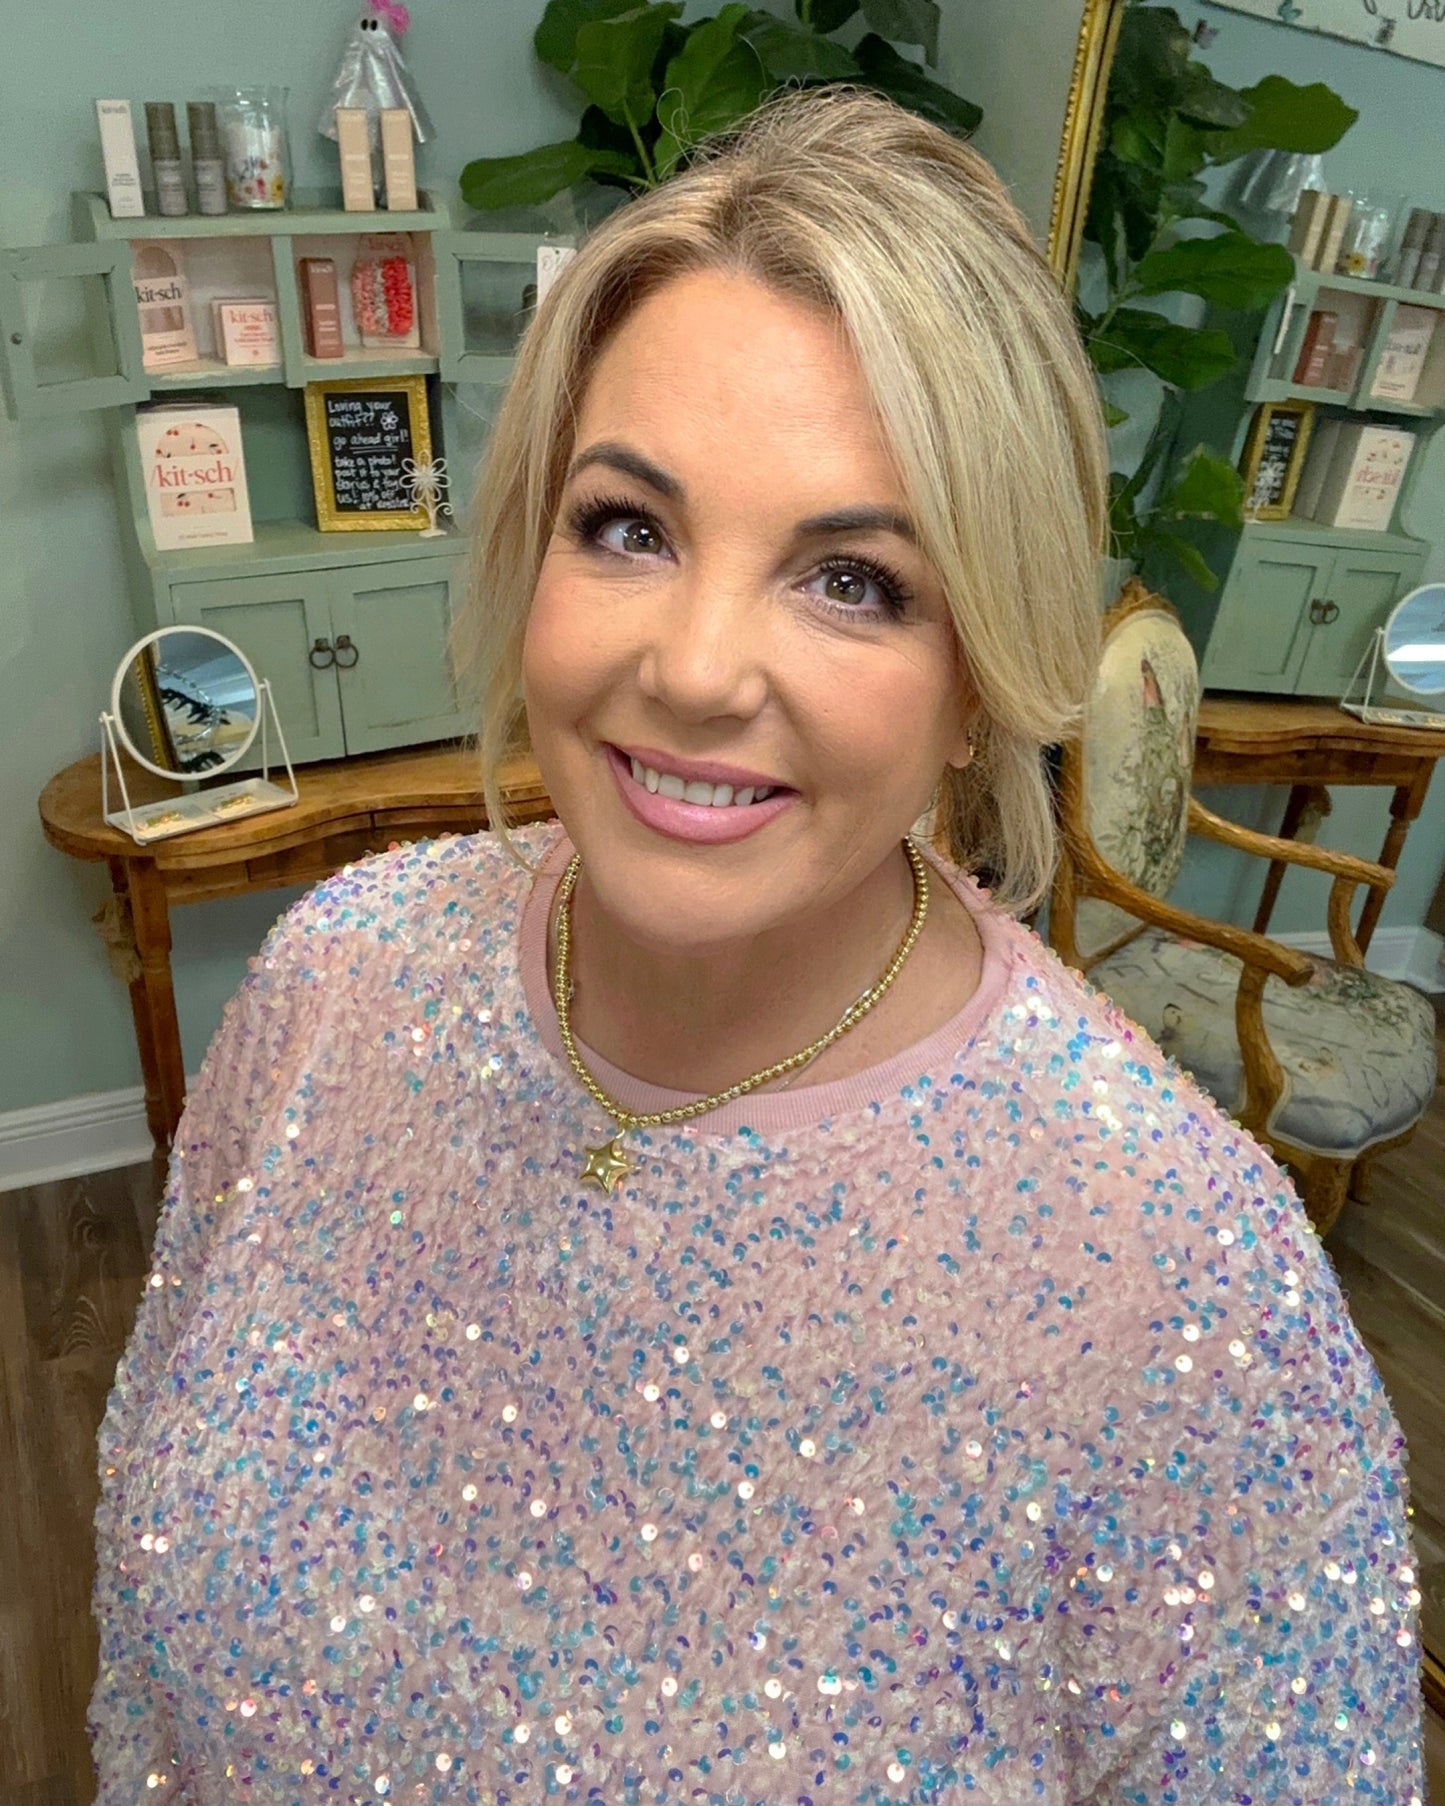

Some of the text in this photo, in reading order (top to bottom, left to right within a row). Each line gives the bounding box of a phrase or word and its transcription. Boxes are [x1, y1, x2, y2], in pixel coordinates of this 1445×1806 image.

[366, 402, 392, 415] your
[333, 436, 347, 451] go
[350, 432, 381, 445] ahead
